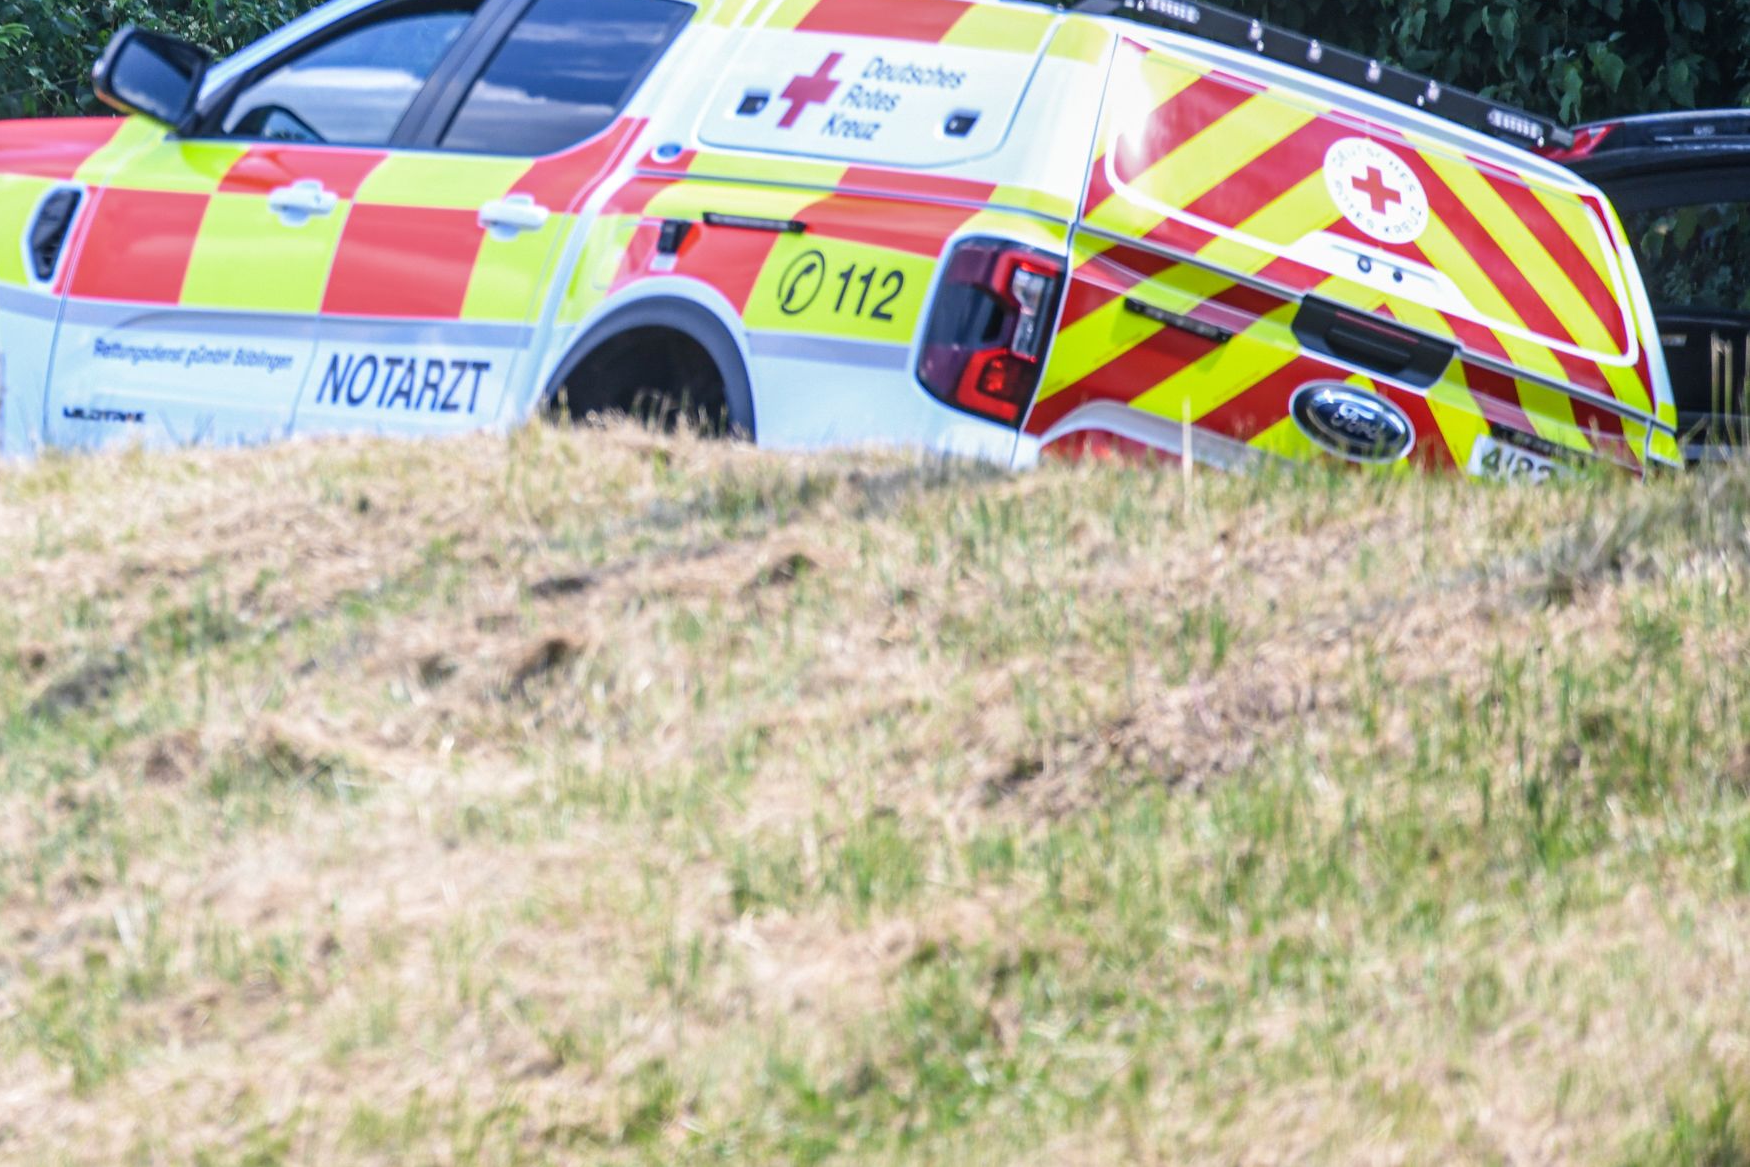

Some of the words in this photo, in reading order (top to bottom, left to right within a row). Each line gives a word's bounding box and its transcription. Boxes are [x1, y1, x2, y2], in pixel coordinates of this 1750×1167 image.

[861, 55, 967, 89] Deutsches
[839, 83, 902, 113] Rotes
[820, 112, 882, 142] Kreuz
[833, 263, 906, 323] 112
[315, 352, 492, 415] NOTARZT
